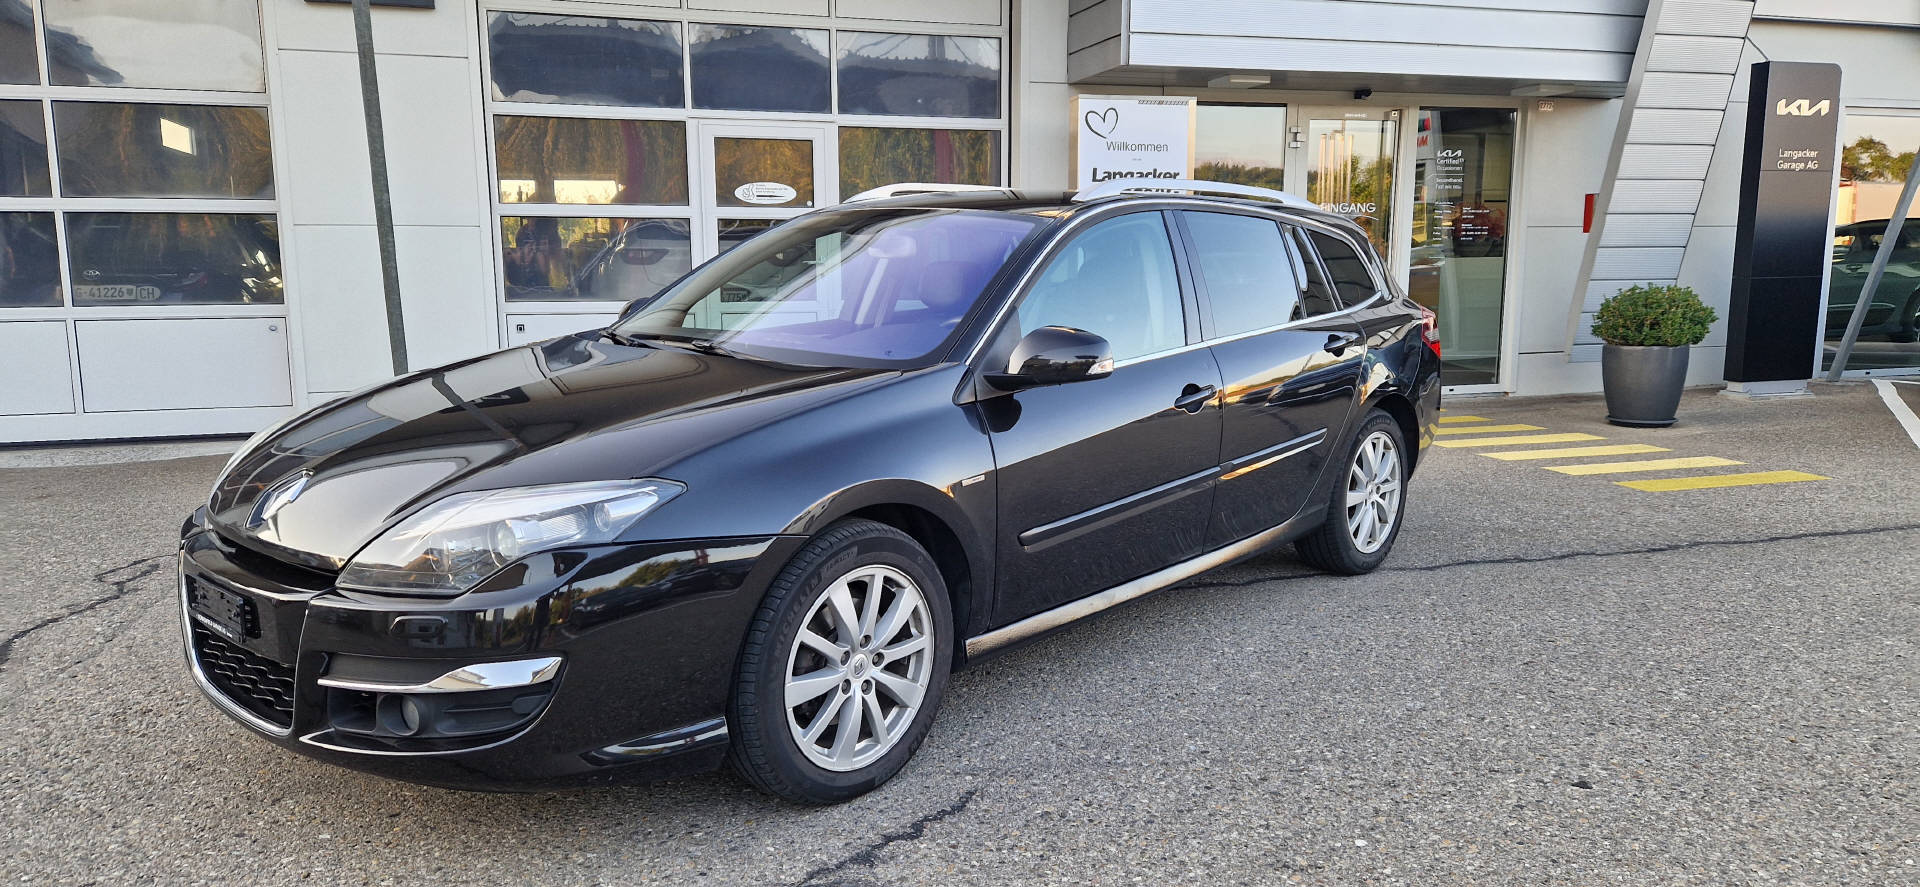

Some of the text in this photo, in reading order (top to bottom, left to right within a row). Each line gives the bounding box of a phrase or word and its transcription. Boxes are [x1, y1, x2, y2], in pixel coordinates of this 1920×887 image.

[1106, 141, 1169, 152] Willkommen
[1779, 148, 1818, 159] Langacker
[1777, 160, 1818, 171] Garage AG
[1321, 202, 1377, 213] EINGANG
[140, 287, 155, 300] CH
